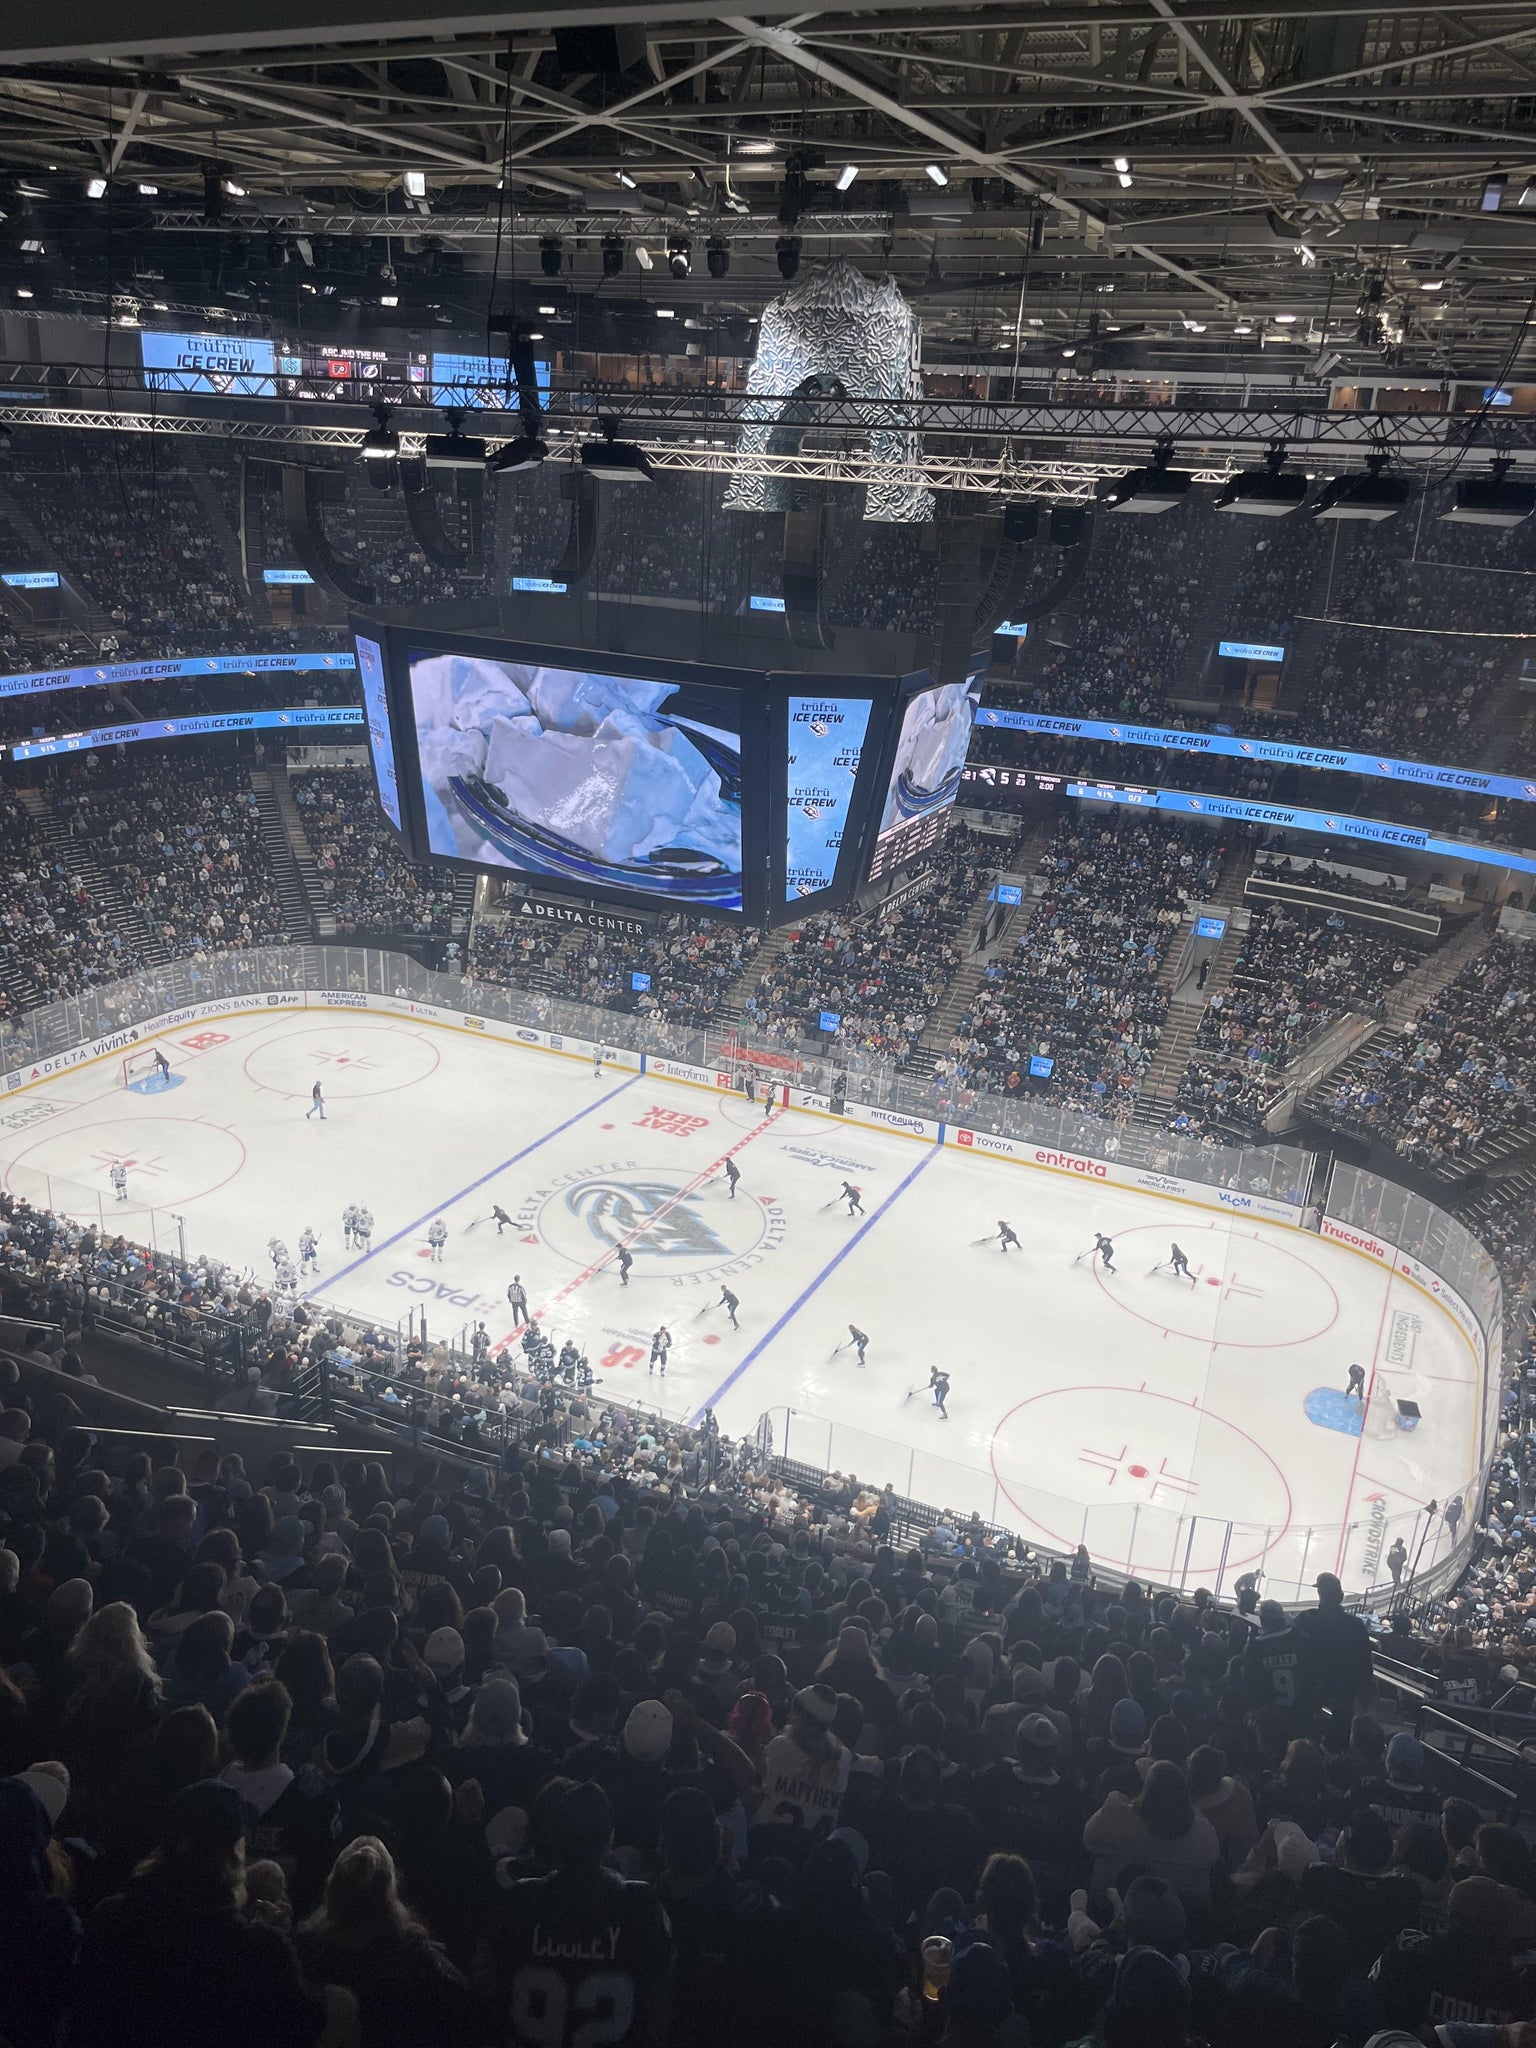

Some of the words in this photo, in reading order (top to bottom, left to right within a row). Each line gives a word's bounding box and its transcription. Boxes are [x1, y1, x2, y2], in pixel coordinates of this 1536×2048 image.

[187, 337, 243, 355] trüfrü
[176, 354, 202, 368] ICE
[205, 356, 254, 371] CREW
[111, 668, 139, 678] trüfrü
[140, 665, 154, 675] ICE
[156, 663, 182, 674] CREW
[223, 660, 253, 669] trüfrü
[255, 659, 269, 667] ICE
[270, 658, 297, 667] CREW
[31, 679, 45, 689] ICE
[45, 674, 71, 686] CREW
[801, 702, 838, 713] trüfrü
[180, 722, 209, 732] trüfrü
[211, 719, 226, 728] ICE
[227, 717, 254, 727] CREW
[296, 714, 325, 723] trüfrü
[327, 713, 342, 721] ICE
[792, 713, 810, 723] ICE
[811, 714, 845, 724] CREW
[1003, 716, 1035, 726] trüfrü
[1036, 719, 1052, 730] ICE
[1052, 721, 1082, 732] CREW
[101, 731, 114, 742] ICE
[115, 728, 140, 740] CREW
[1126, 730, 1160, 742] trüfrü
[1162, 734, 1178, 744] ICE
[1179, 737, 1211, 748] CREW
[68, 740, 80, 749] 0/3
[833, 757, 851, 767] ICE
[1259, 746, 1294, 759] trüfrü
[1296, 751, 1313, 761] ICE
[1314, 753, 1348, 766] CREW
[1000, 772, 1010, 784] 5
[1016, 779, 1026, 787] 23
[1397, 766, 1433, 780] trüfrü
[1436, 771, 1454, 783] ICE
[1455, 775, 1491, 789] CREW
[794, 787, 830, 797] trüfrü
[1038, 782, 1054, 791] 2:00
[1097, 790, 1114, 799] 41%
[804, 798, 837, 808] CREW
[1128, 795, 1142, 803] 0/3
[1208, 803, 1242, 815] trüfrü
[1244, 807, 1262, 818] ICE
[1263, 810, 1295, 823] CREW
[1344, 823, 1379, 837] trüfrü
[1381, 828, 1400, 840] ICE
[825, 838, 842, 848] ICE
[788, 868, 823, 877] trüfrü
[786, 877, 796, 886] CE
[797, 877, 829, 887] CREW
[886, 893, 907, 913] DELTA
[908, 877, 931, 899] CENTER
[536, 904, 583, 923] DELTA
[588, 915, 643, 935] CENTER
[321, 992, 367, 1000] AMERICAN
[327, 999, 368, 1007] EXPRESS
[201, 1002, 231, 1015] ZIONS
[234, 998, 263, 1009] BANK
[415, 1008, 438, 1017] ULTRA
[143, 1010, 197, 1032] HealthEquity
[519, 1031, 537, 1042] Ford
[44, 1050, 88, 1073] DELTA
[667, 1063, 709, 1083] Interform
[8, 1106, 68, 1130] BANK
[643, 1106, 710, 1128] GEEK
[631, 1117, 697, 1137] SEAT
[976, 1136, 1014, 1153] TOYOTA
[1035, 1150, 1107, 1178] entrata
[551, 1160, 638, 1187] CENTER
[1137, 1178, 1166, 1190] AMERICA
[1167, 1185, 1186, 1194] FIRST
[758, 1207, 787, 1252] DELTA
[1323, 1220, 1385, 1258] Trucordia
[672, 1254, 763, 1287] CENTER
[386, 1271, 481, 1308] PACS
[1440, 1289, 1460, 1312] Select
[1411, 1315, 1424, 1334] JUST
[1390, 1315, 1409, 1363] INGREDIENTS
[1363, 1497, 1387, 1577] CROWDSTRIKE
[764, 1625, 798, 1641] COOLEY
[1273, 1669, 1296, 1707] 9
[776, 1776, 839, 1809] MATTHEW
[511, 1966, 635, 2048] 92
